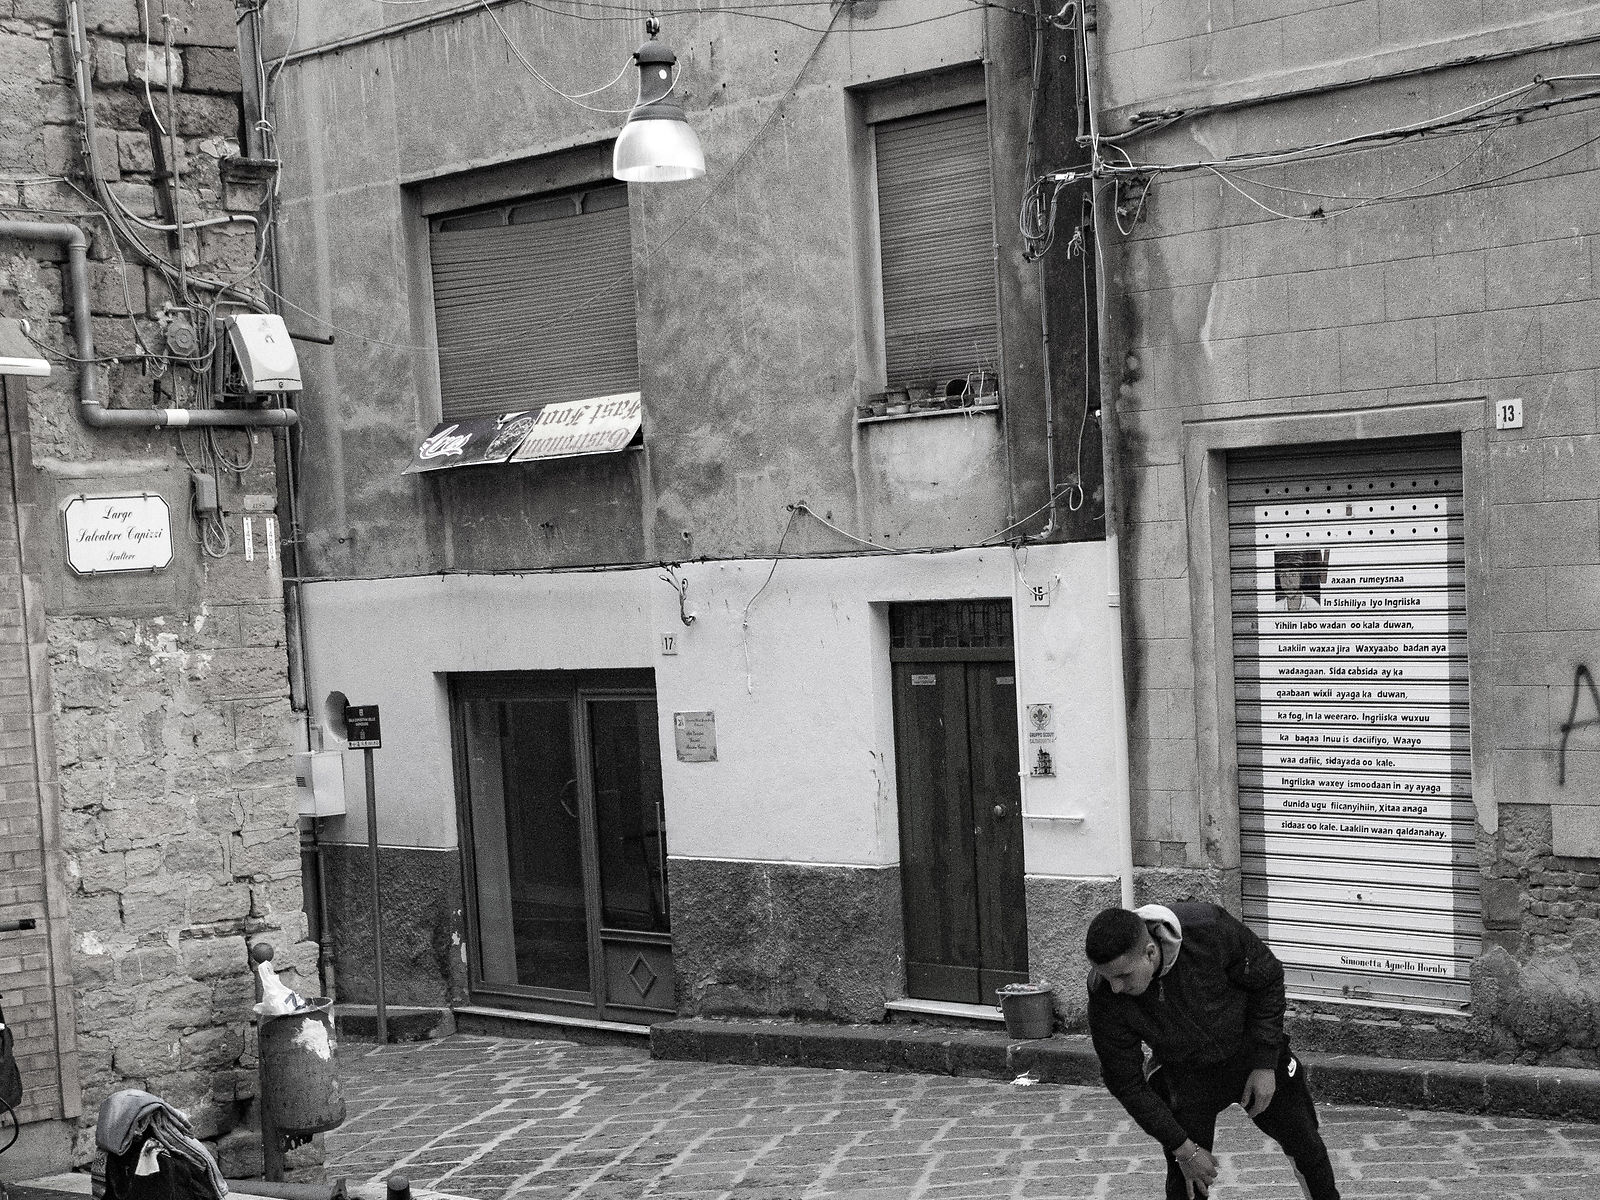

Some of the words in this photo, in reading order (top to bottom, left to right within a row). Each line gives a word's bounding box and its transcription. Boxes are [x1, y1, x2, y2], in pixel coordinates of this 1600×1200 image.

[1502, 404, 1515, 423] 13
[102, 506, 133, 523] Largo
[76, 528, 122, 543] Salvatore
[127, 526, 164, 544] Capizzi
[1359, 576, 1404, 585] rumeysnaa
[1032, 586, 1044, 602] 15
[1333, 598, 1367, 610] Sishiliya
[1384, 597, 1421, 608] Ingriiska
[1274, 621, 1298, 630] Yihiin
[1320, 621, 1347, 629] wadan
[1362, 621, 1380, 629] kala
[1383, 620, 1415, 630] duwan,
[664, 638, 674, 650] 17
[1278, 644, 1306, 652] Laakiin
[1336, 644, 1350, 655] jira
[1355, 644, 1399, 655] Waxyaabo
[1403, 644, 1430, 652] badan
[1431, 645, 1446, 654] aya
[1278, 668, 1326, 677] wadaagaan.
[1329, 667, 1346, 675] Sida
[1347, 666, 1378, 676] cabsida
[1382, 668, 1392, 678] ay
[1393, 668, 1403, 676] ka
[1276, 689, 1310, 699] qaabaan
[1336, 691, 1360, 700] ayaga
[1362, 690, 1372, 698] ka
[1377, 690, 1408, 700] duwan,
[1288, 711, 1304, 722] fog,
[1362, 712, 1398, 724] Ingriiska
[1280, 733, 1289, 741] ka
[1295, 734, 1319, 744] baqaa
[1342, 735, 1350, 743] is
[1393, 736, 1422, 748] Waayo
[1325, 756, 1360, 768] sidayada
[1376, 759, 1396, 767] kale.
[1281, 778, 1316, 788] Ingriiska
[1318, 781, 1344, 790] waxey
[1348, 780, 1392, 789] ismoodaan
[1404, 784, 1415, 792] ay
[1416, 784, 1441, 794] ayaga
[1282, 800, 1310, 808] dunida
[1311, 802, 1327, 811] ugu
[1402, 806, 1428, 815] anaga
[1281, 820, 1305, 830] sidaas
[1319, 822, 1338, 831] kale.
[1340, 824, 1369, 833] Laakiin
[1370, 827, 1393, 835] waan
[1396, 828, 1447, 840] qaldanahay.
[1340, 955, 1382, 968] Simonetta
[1384, 960, 1415, 972] Agnello
[1417, 962, 1448, 975] Hornby
